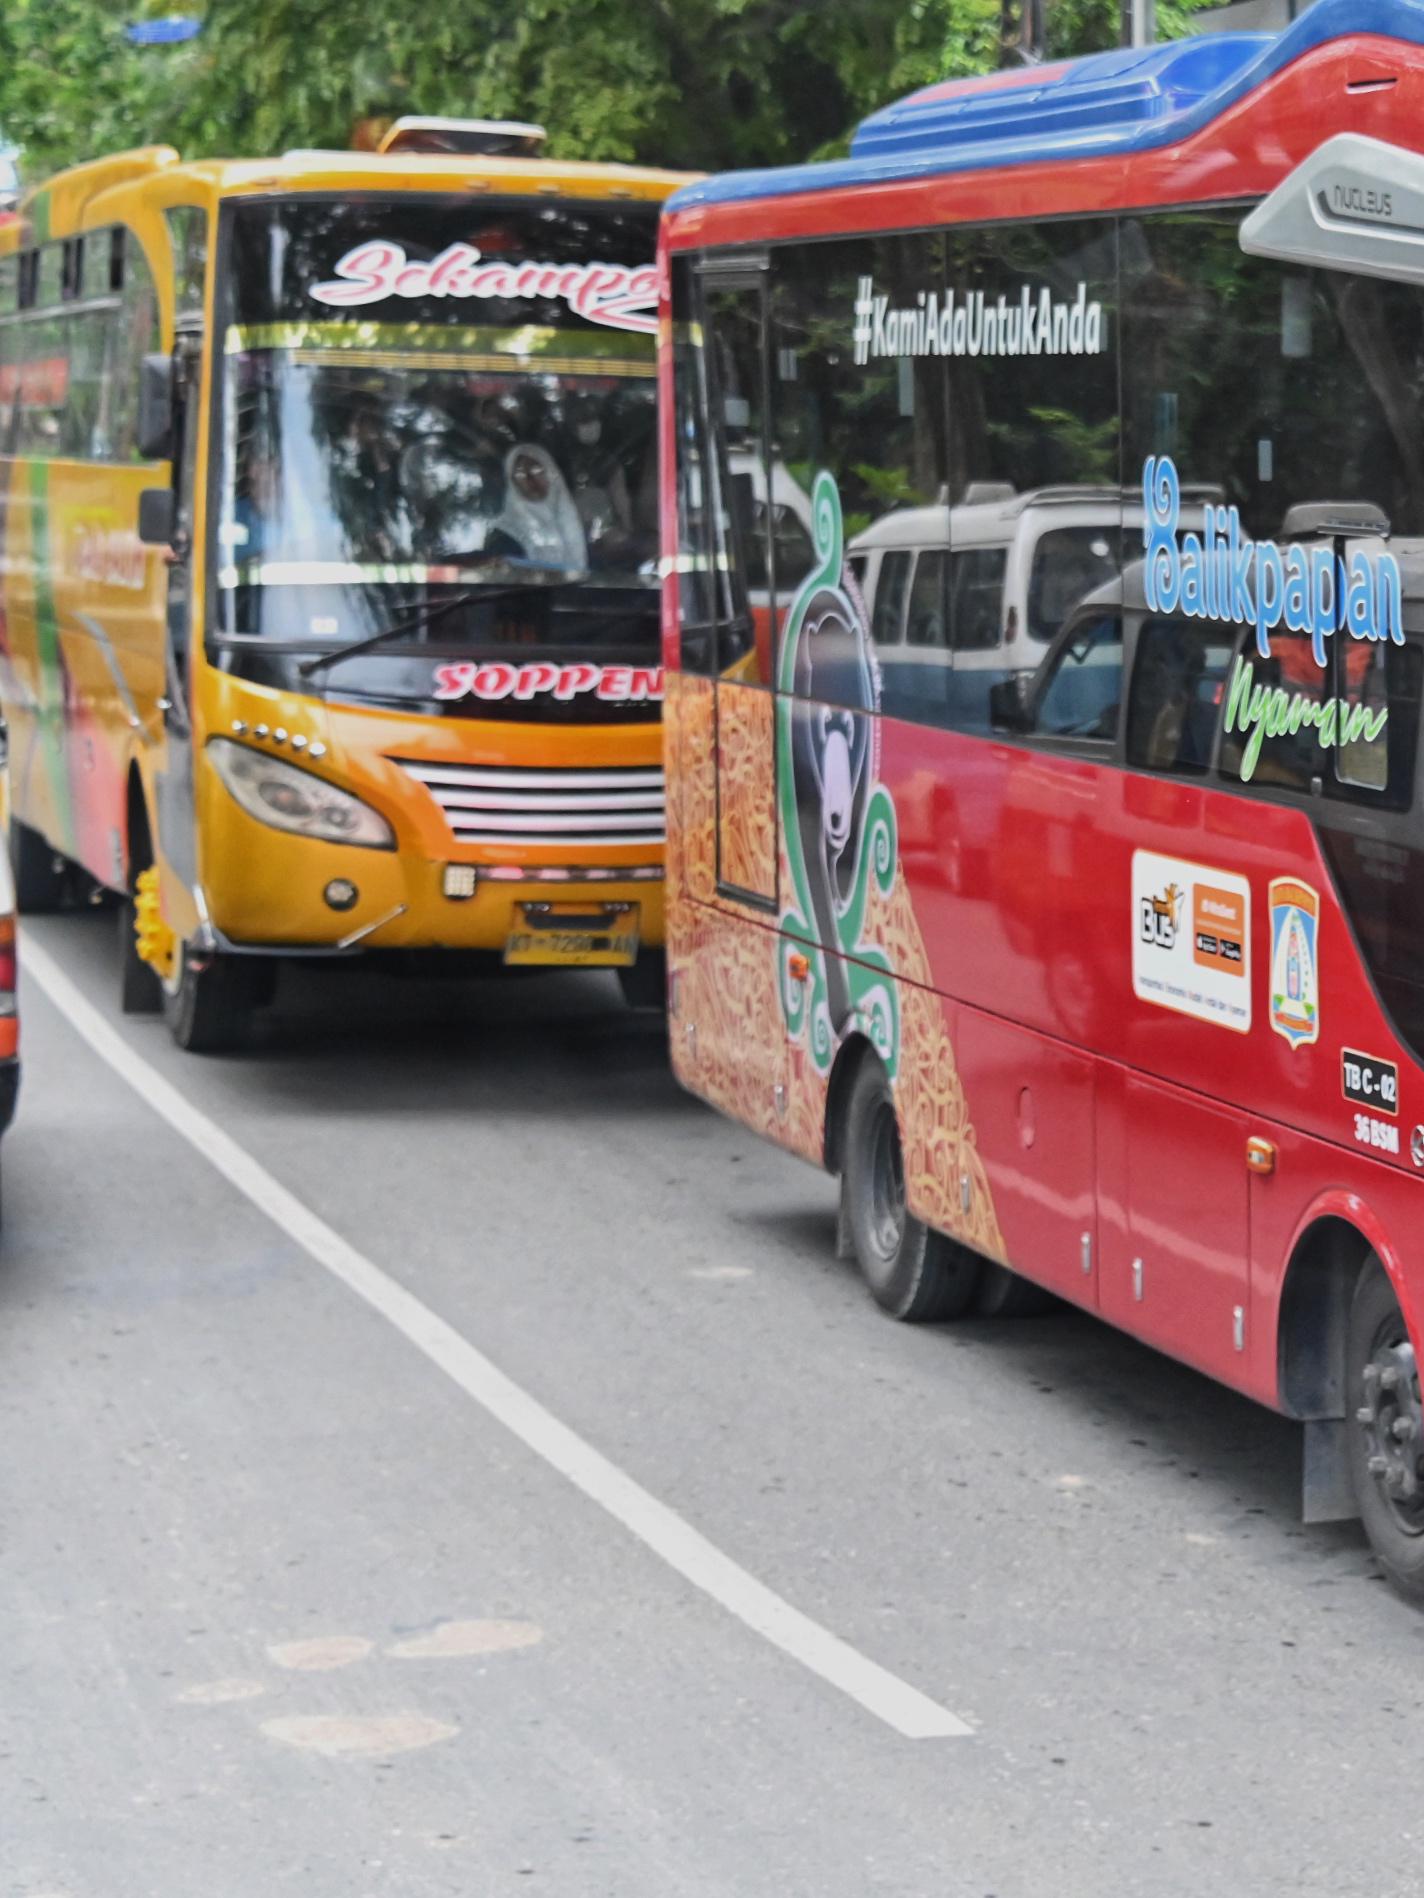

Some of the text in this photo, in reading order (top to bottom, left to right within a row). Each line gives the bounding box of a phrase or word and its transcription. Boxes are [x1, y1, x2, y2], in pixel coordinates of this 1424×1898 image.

[1333, 185, 1393, 216] NUCLEUS
[853, 275, 1102, 366] #KamiAdaUntukAnda
[1142, 455, 1406, 668] Balikpapan
[433, 661, 664, 700] SOPPEN
[1224, 655, 1389, 782] Nyaman
